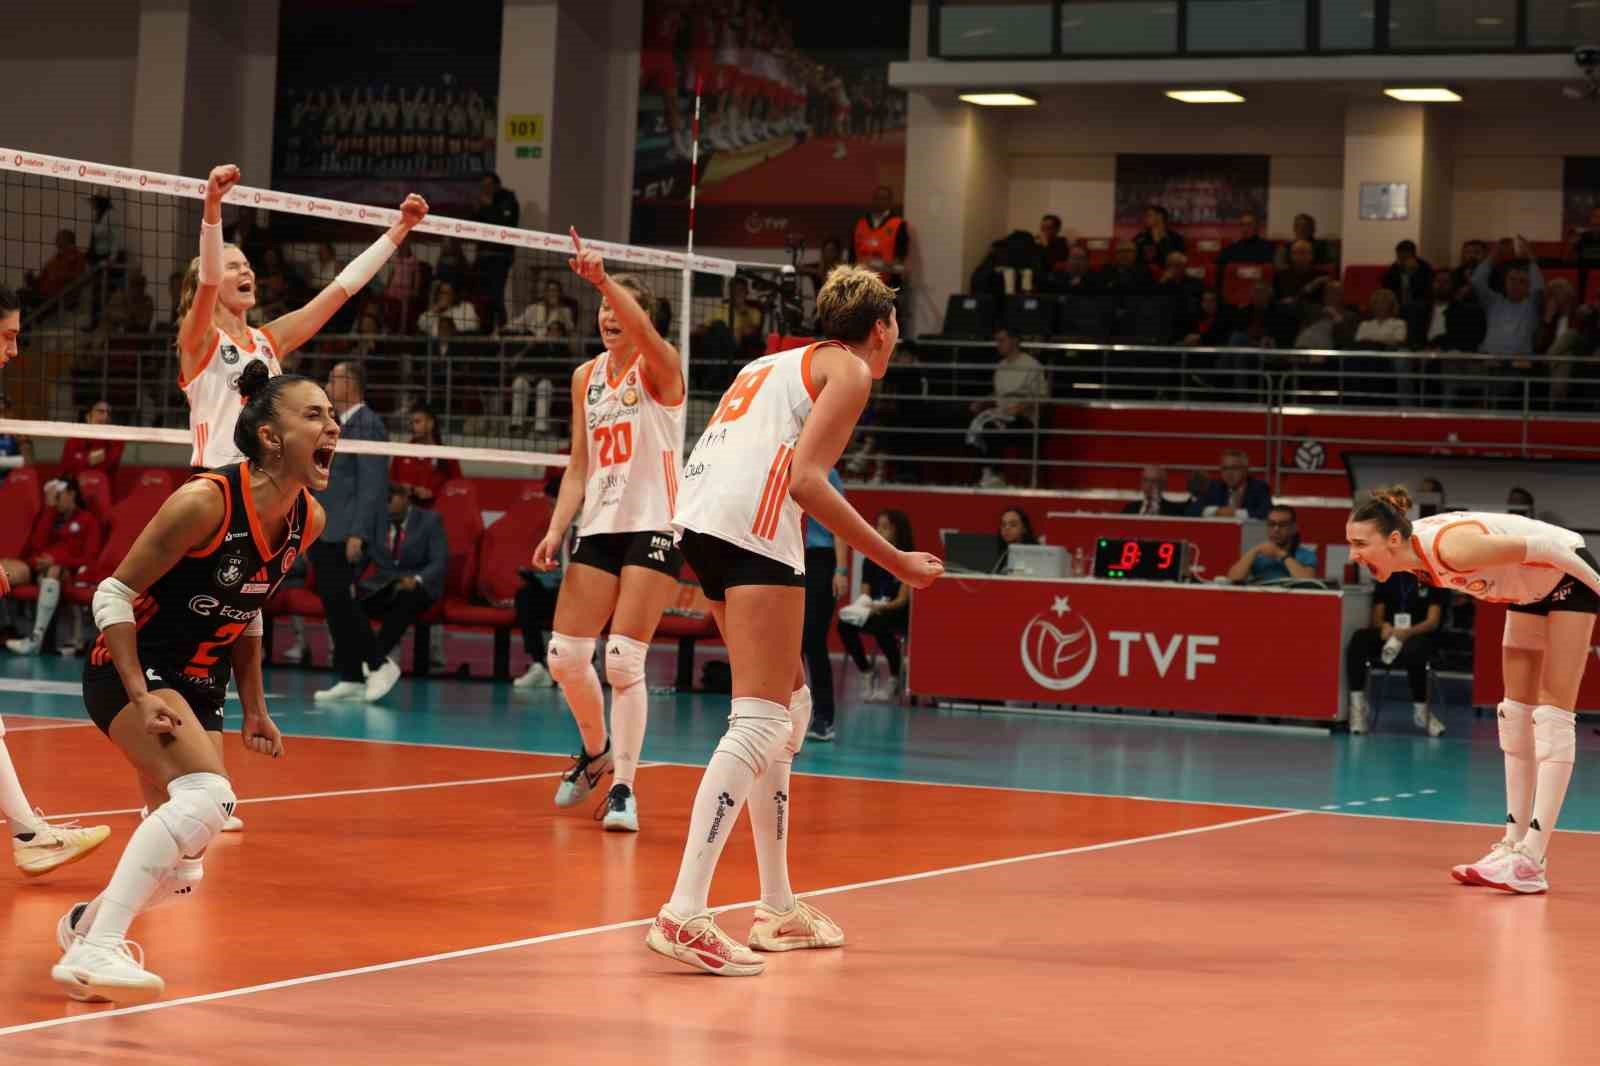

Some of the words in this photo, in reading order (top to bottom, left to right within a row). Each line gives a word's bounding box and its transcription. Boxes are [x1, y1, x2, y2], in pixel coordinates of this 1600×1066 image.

[510, 121, 537, 137] 101
[593, 421, 632, 468] 20
[1157, 543, 1175, 569] 9
[191, 622, 248, 666] 2
[1108, 630, 1219, 680] TVF
